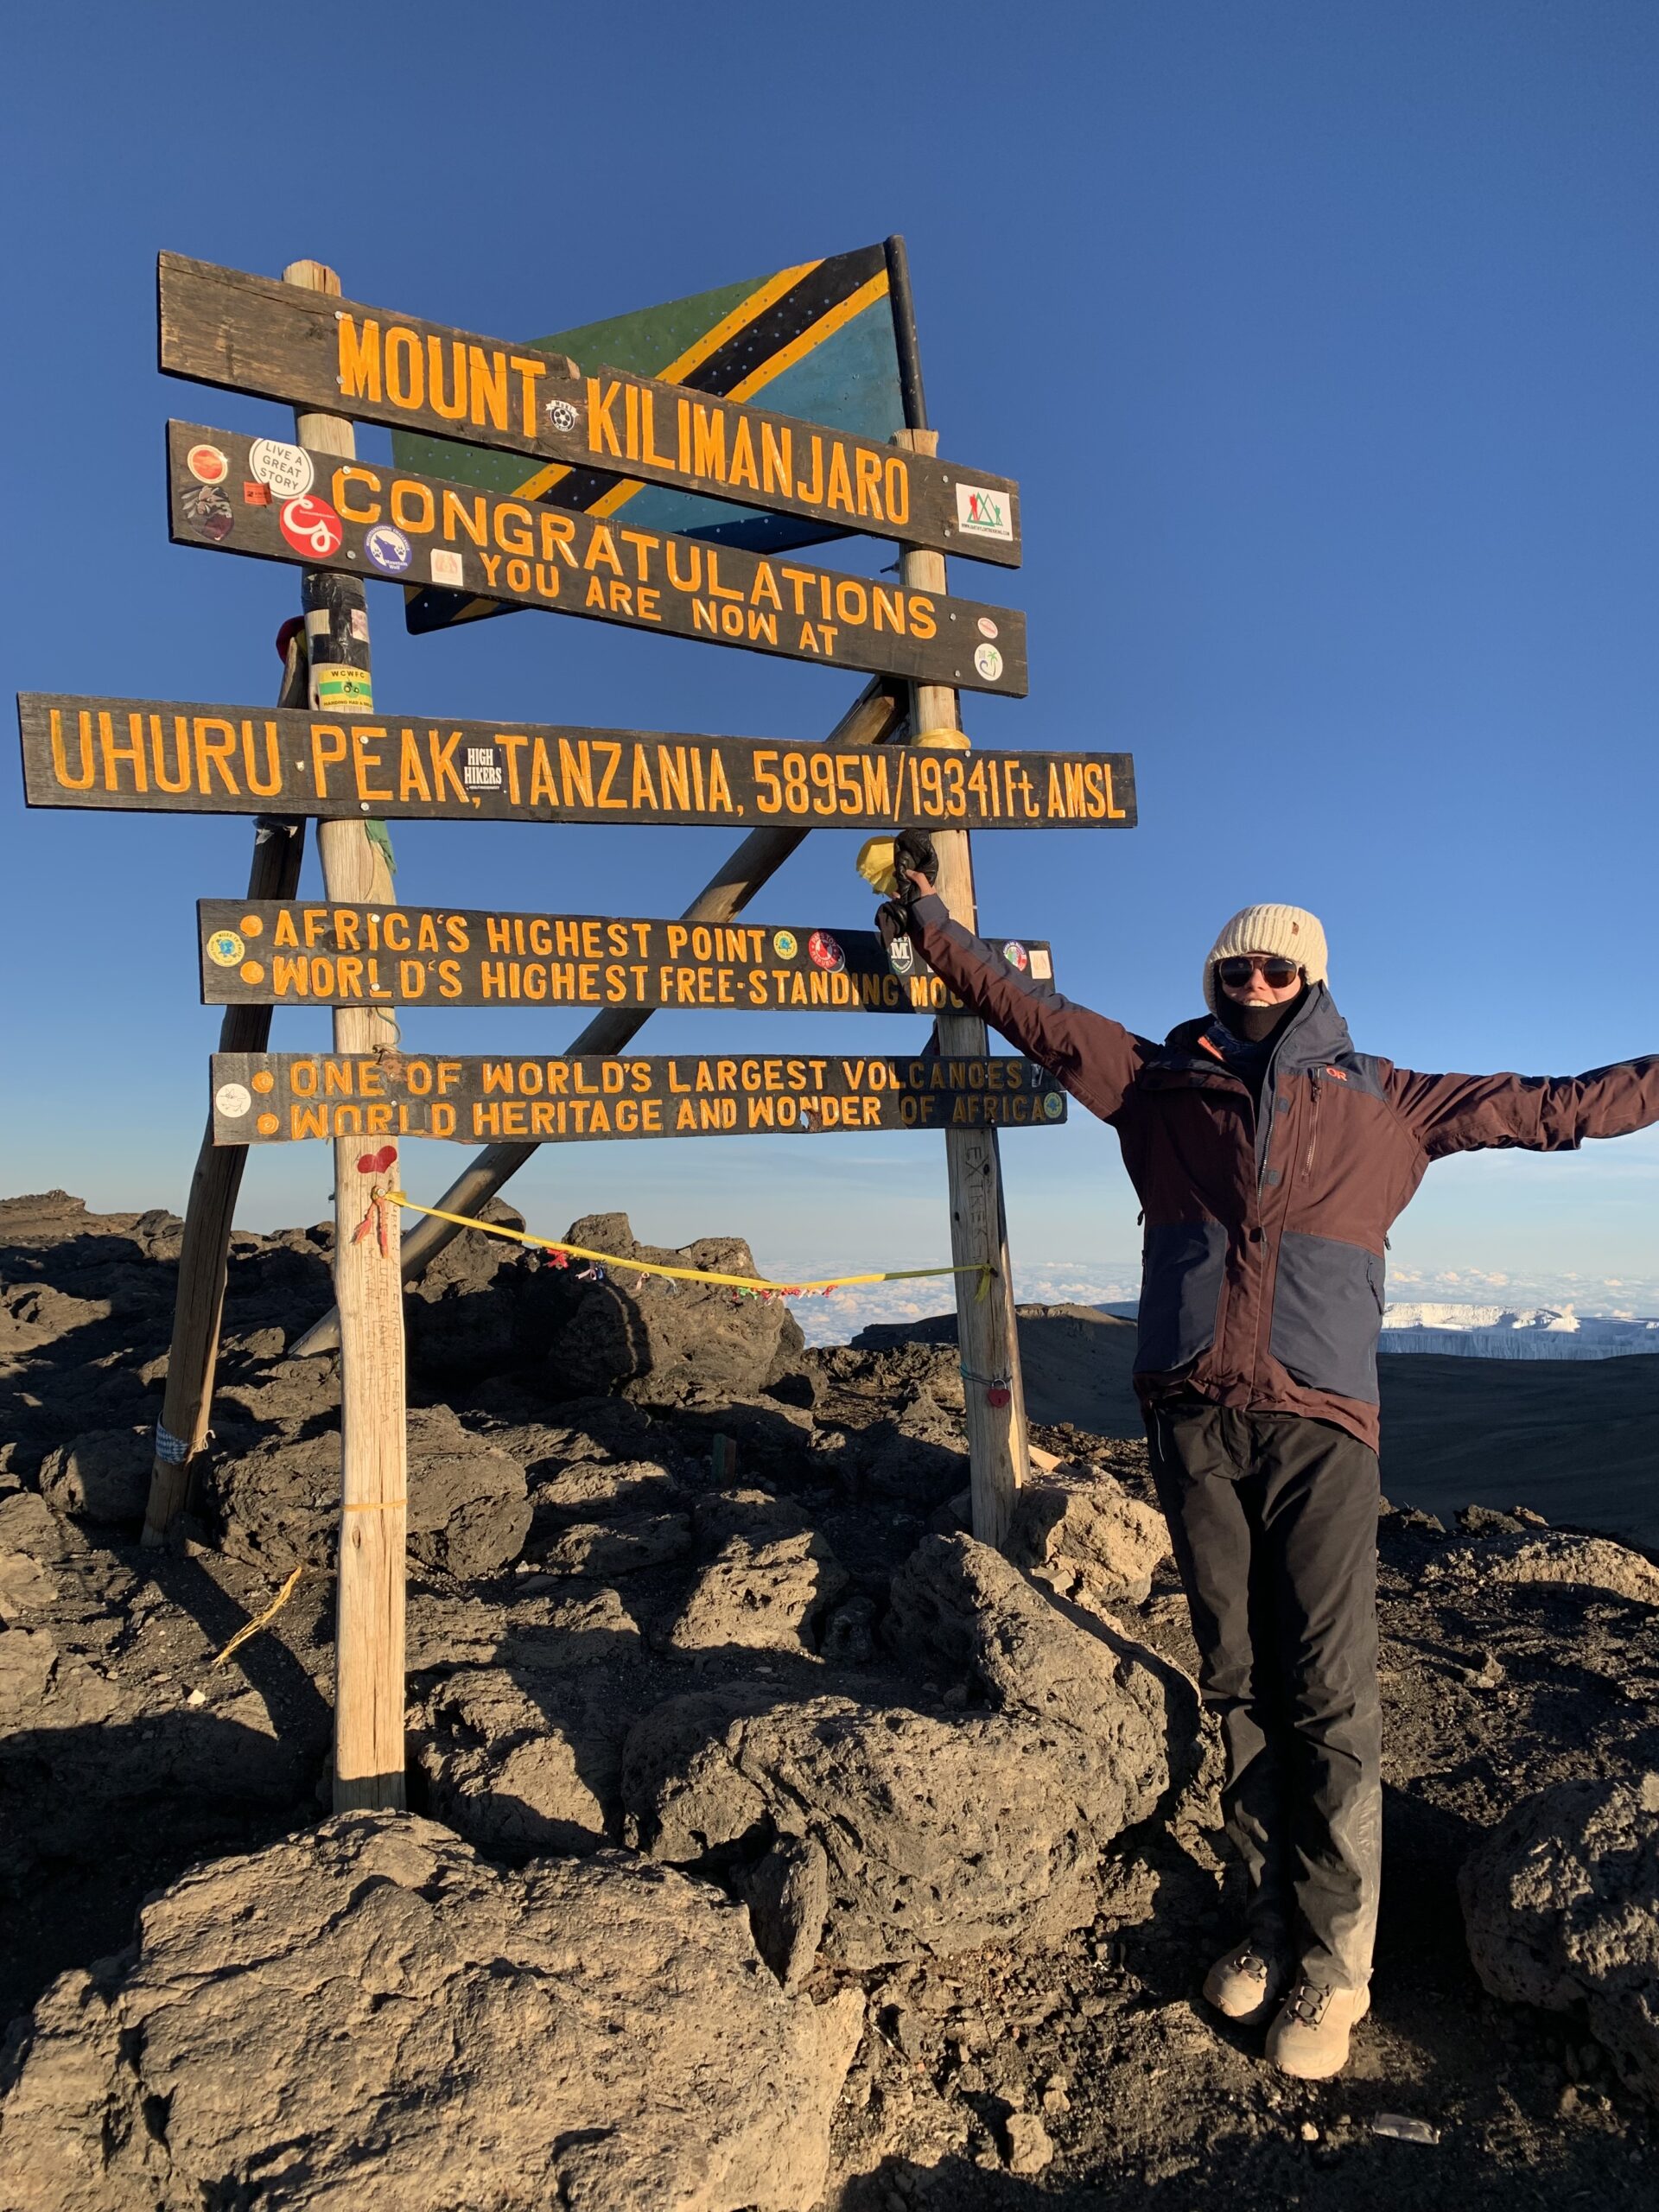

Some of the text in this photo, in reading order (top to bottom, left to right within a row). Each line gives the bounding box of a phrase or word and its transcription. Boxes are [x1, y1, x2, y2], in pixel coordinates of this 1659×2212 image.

[338, 313, 910, 525] MOUNT KILIMANJARO
[263, 454, 302, 478] GREAT
[265, 442, 302, 466] LIVE A
[259, 467, 298, 490] STORY
[332, 467, 938, 639] CONGRATULATIONS
[480, 551, 838, 657] YOU ARE NOW AT
[50, 709, 283, 797] UHURU
[311, 723, 482, 809] PEAK,
[495, 734, 744, 817] TANZANIA,
[1047, 762, 1126, 819] AMSL
[467, 747, 493, 766] HIGH
[464, 766, 502, 785] HIKERS
[274, 909, 470, 953] AFRICA'S
[486, 918, 652, 958] HIGHEST
[666, 925, 766, 963] POINT
[891, 942, 910, 959] M
[273, 956, 463, 998] WORLD'S
[481, 961, 649, 1001] HIGHEST
[660, 966, 899, 1007] FREE-STANDING
[290, 1060, 1023, 1096] ONE OF WORLD'S LARGEST VOLCANOES
[1326, 1067, 1347, 1081] OR
[290, 1103, 456, 1140] WORLD
[473, 1101, 663, 1135] HERITAGE
[677, 1098, 737, 1130] AND
[747, 1096, 882, 1128] WONDER
[900, 1096, 934, 1125] OF
[952, 1093, 1046, 1122] AFRICA
